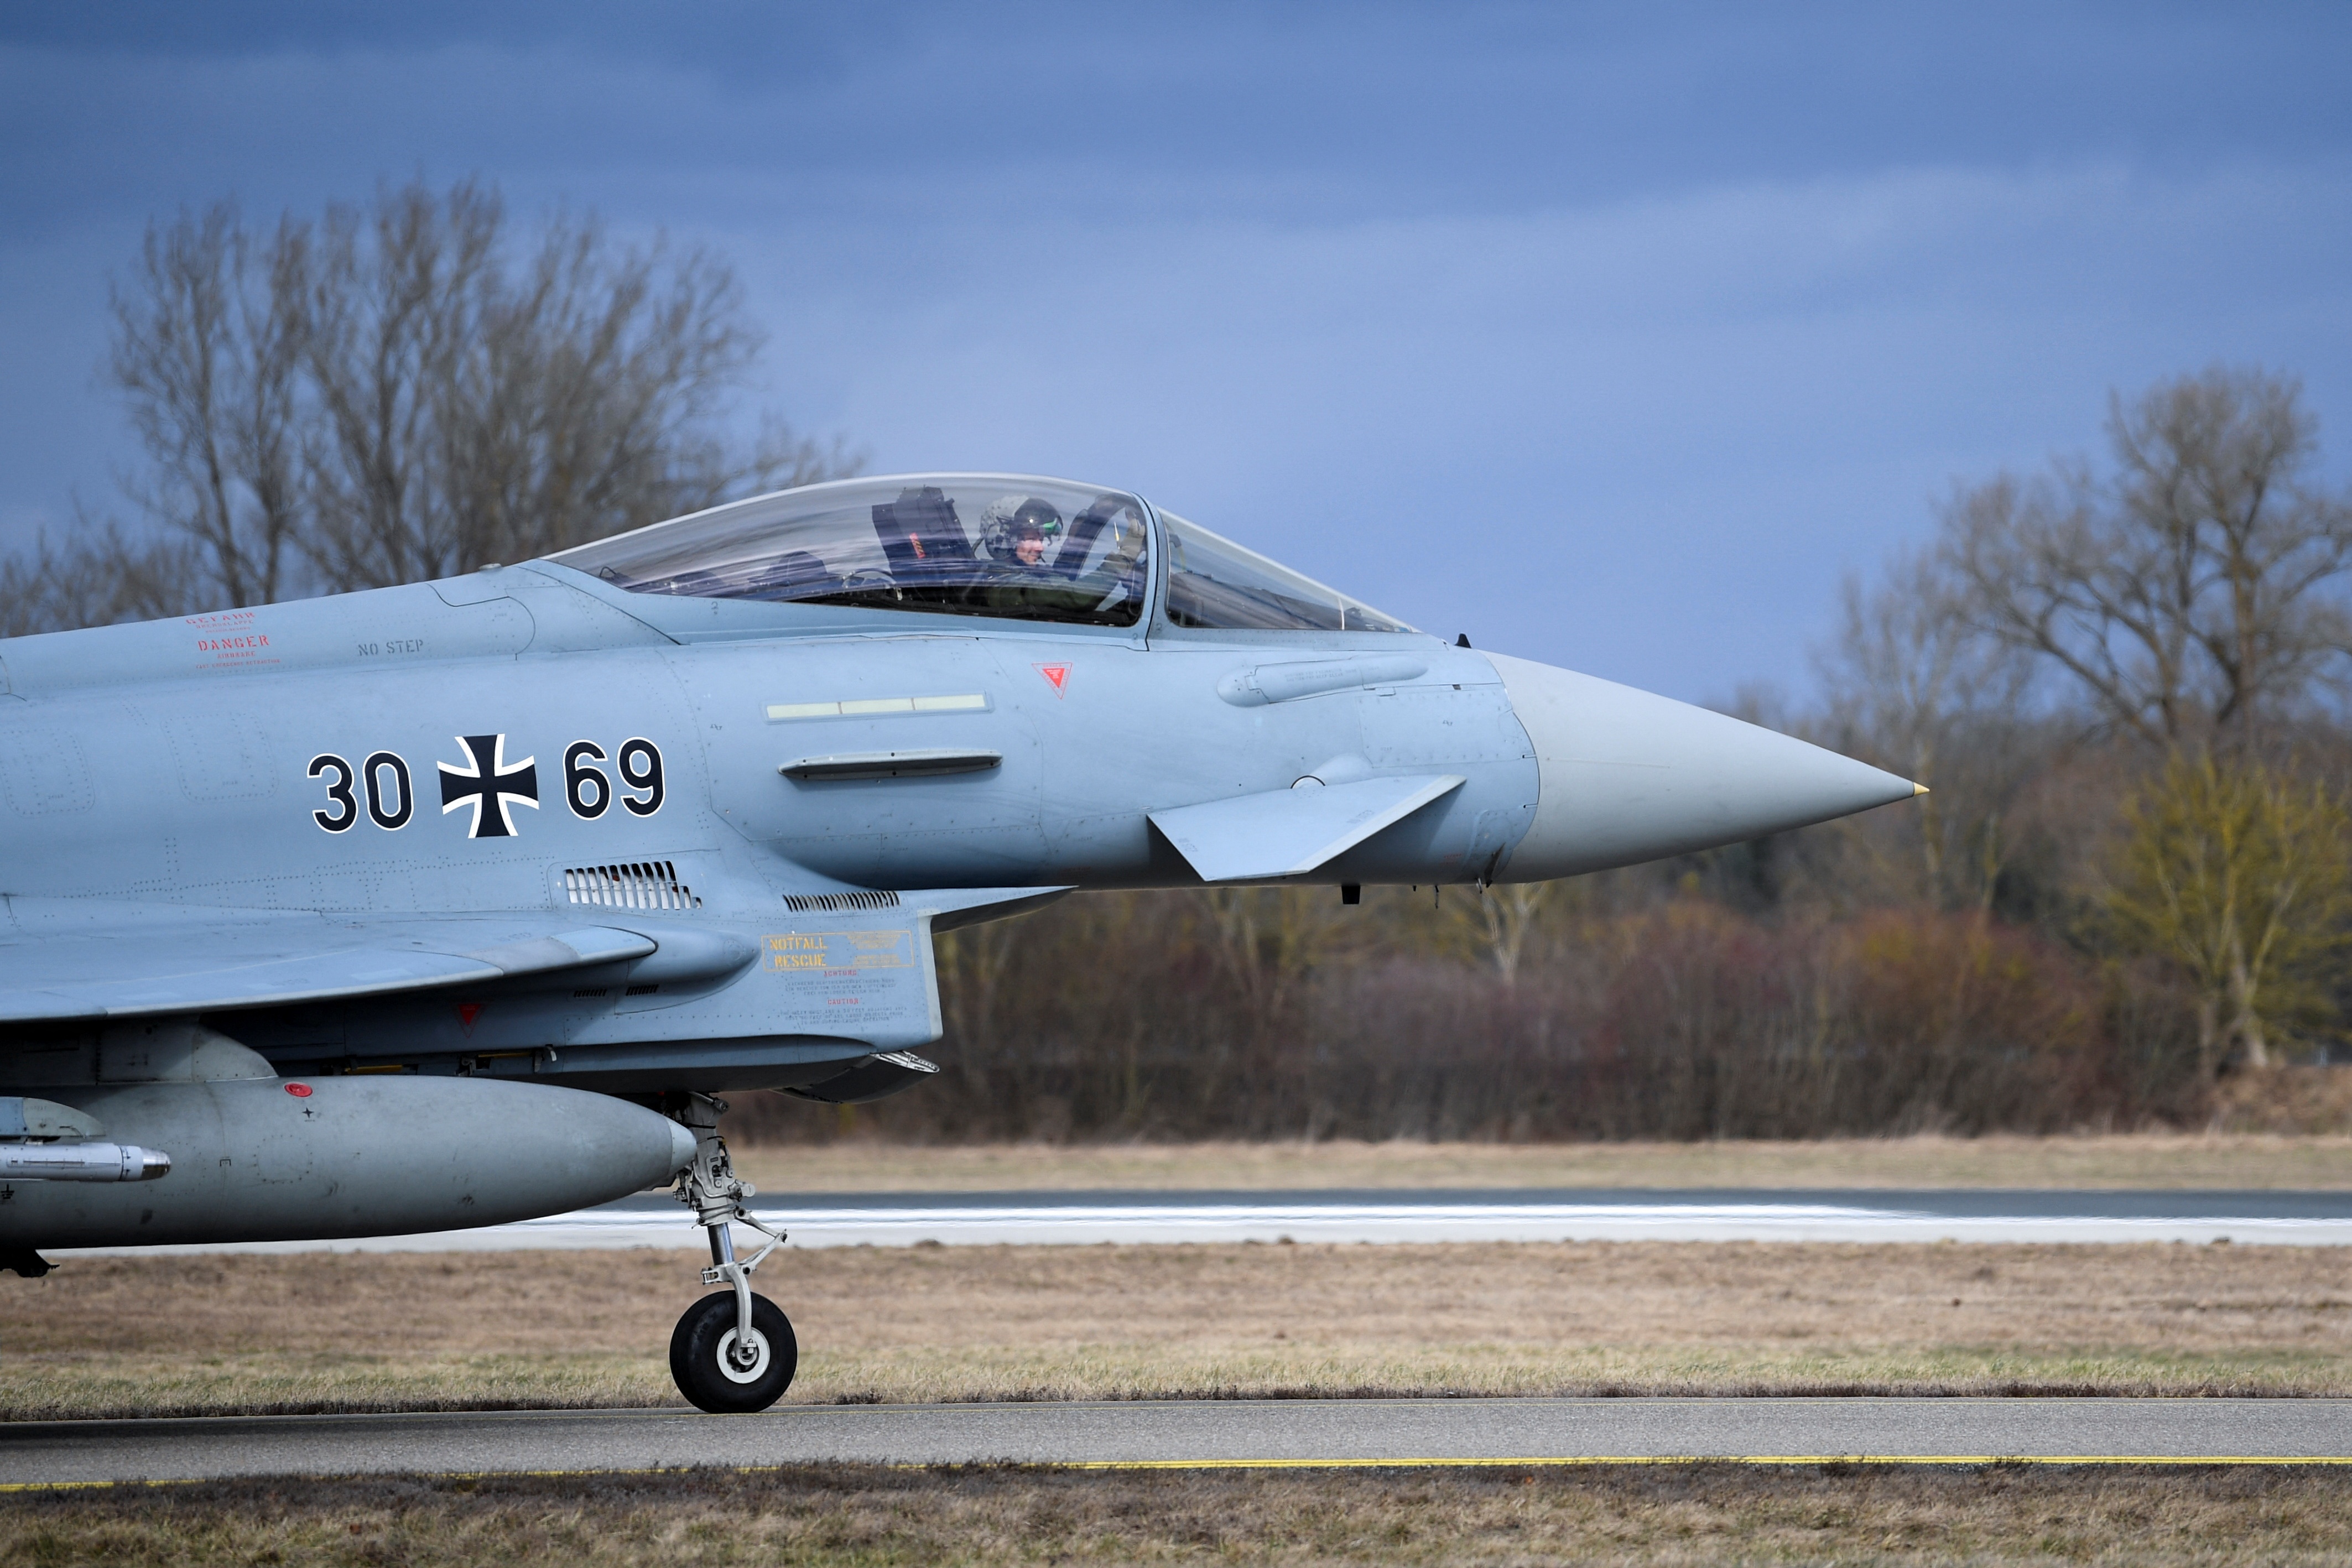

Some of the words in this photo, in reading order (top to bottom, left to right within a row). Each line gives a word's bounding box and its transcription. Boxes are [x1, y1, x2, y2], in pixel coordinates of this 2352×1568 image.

[197, 634, 270, 652] DANGER
[358, 643, 378, 657] NO
[386, 639, 424, 655] STEP
[306, 749, 414, 834] 30
[562, 736, 666, 821] 69
[769, 936, 828, 951] NOTFALL
[774, 954, 827, 968] RESCUE
